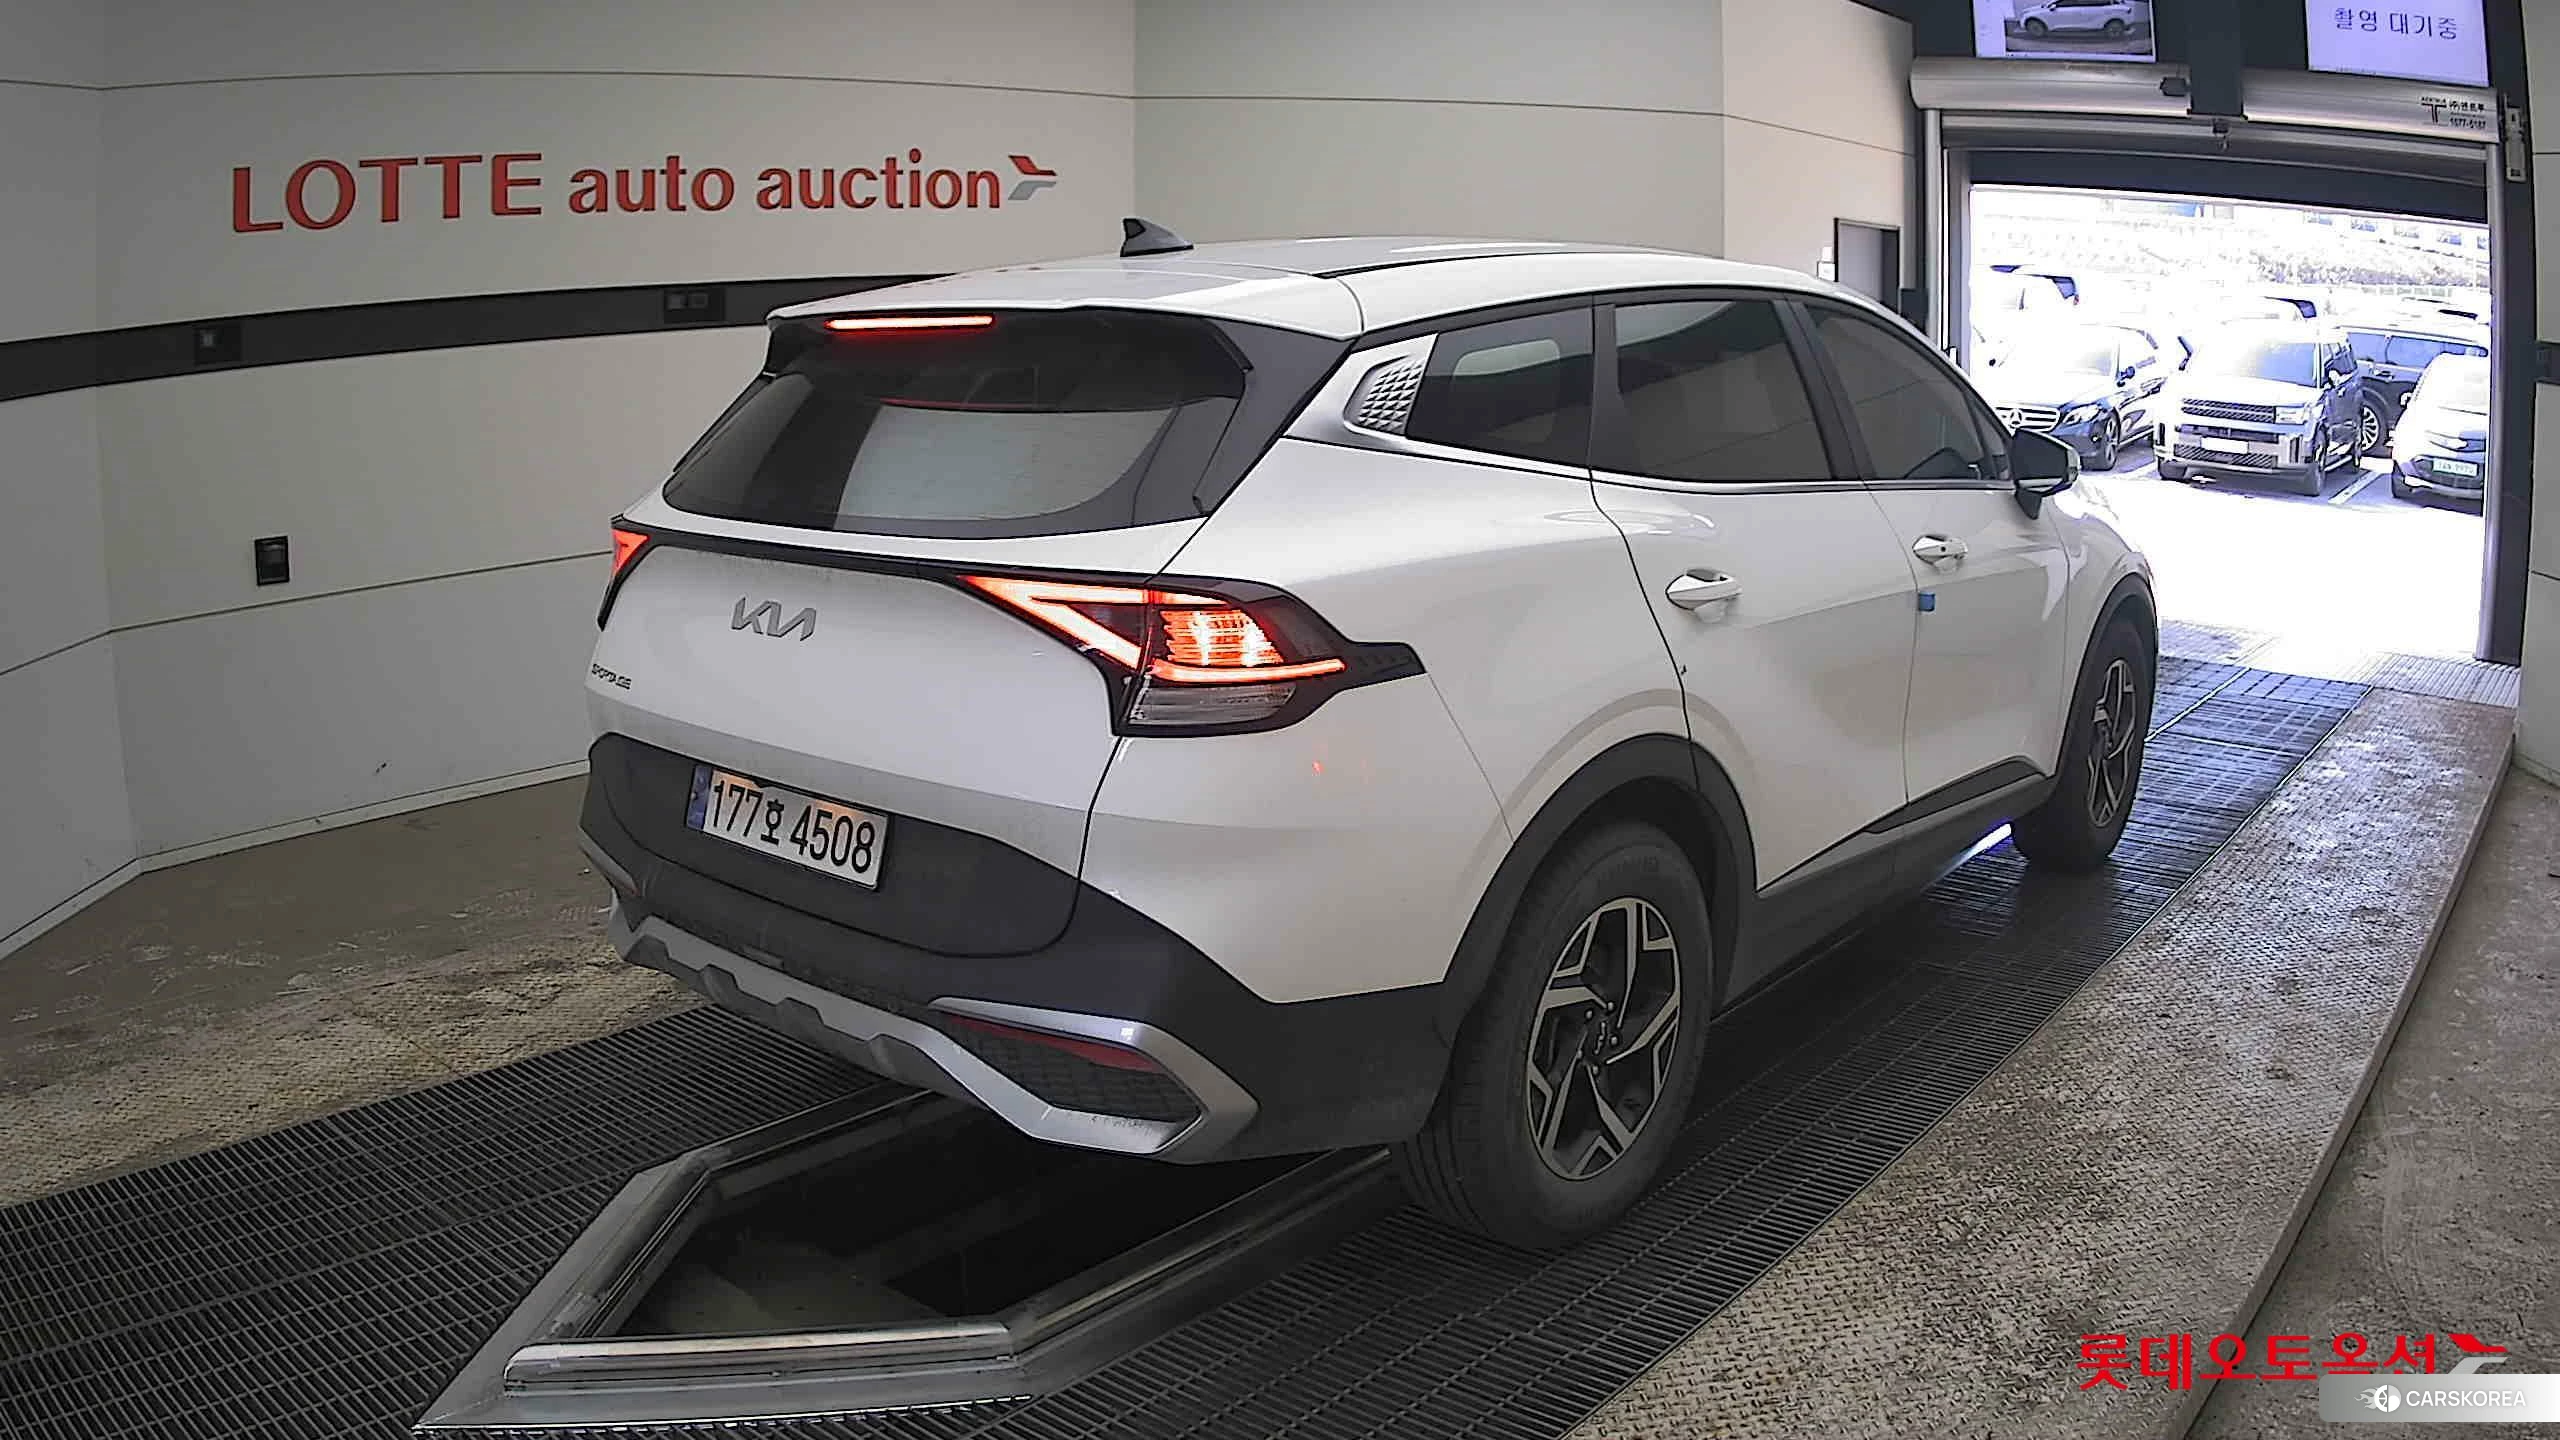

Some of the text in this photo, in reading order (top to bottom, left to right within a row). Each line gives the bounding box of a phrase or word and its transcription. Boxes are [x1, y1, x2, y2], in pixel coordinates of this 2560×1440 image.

[2335, 8, 2457, 40] 촬영 대기중
[233, 147, 1001, 233] LOTTE auto auction
[731, 596, 818, 642] KIA
[713, 780, 876, 875] 177호 4508
